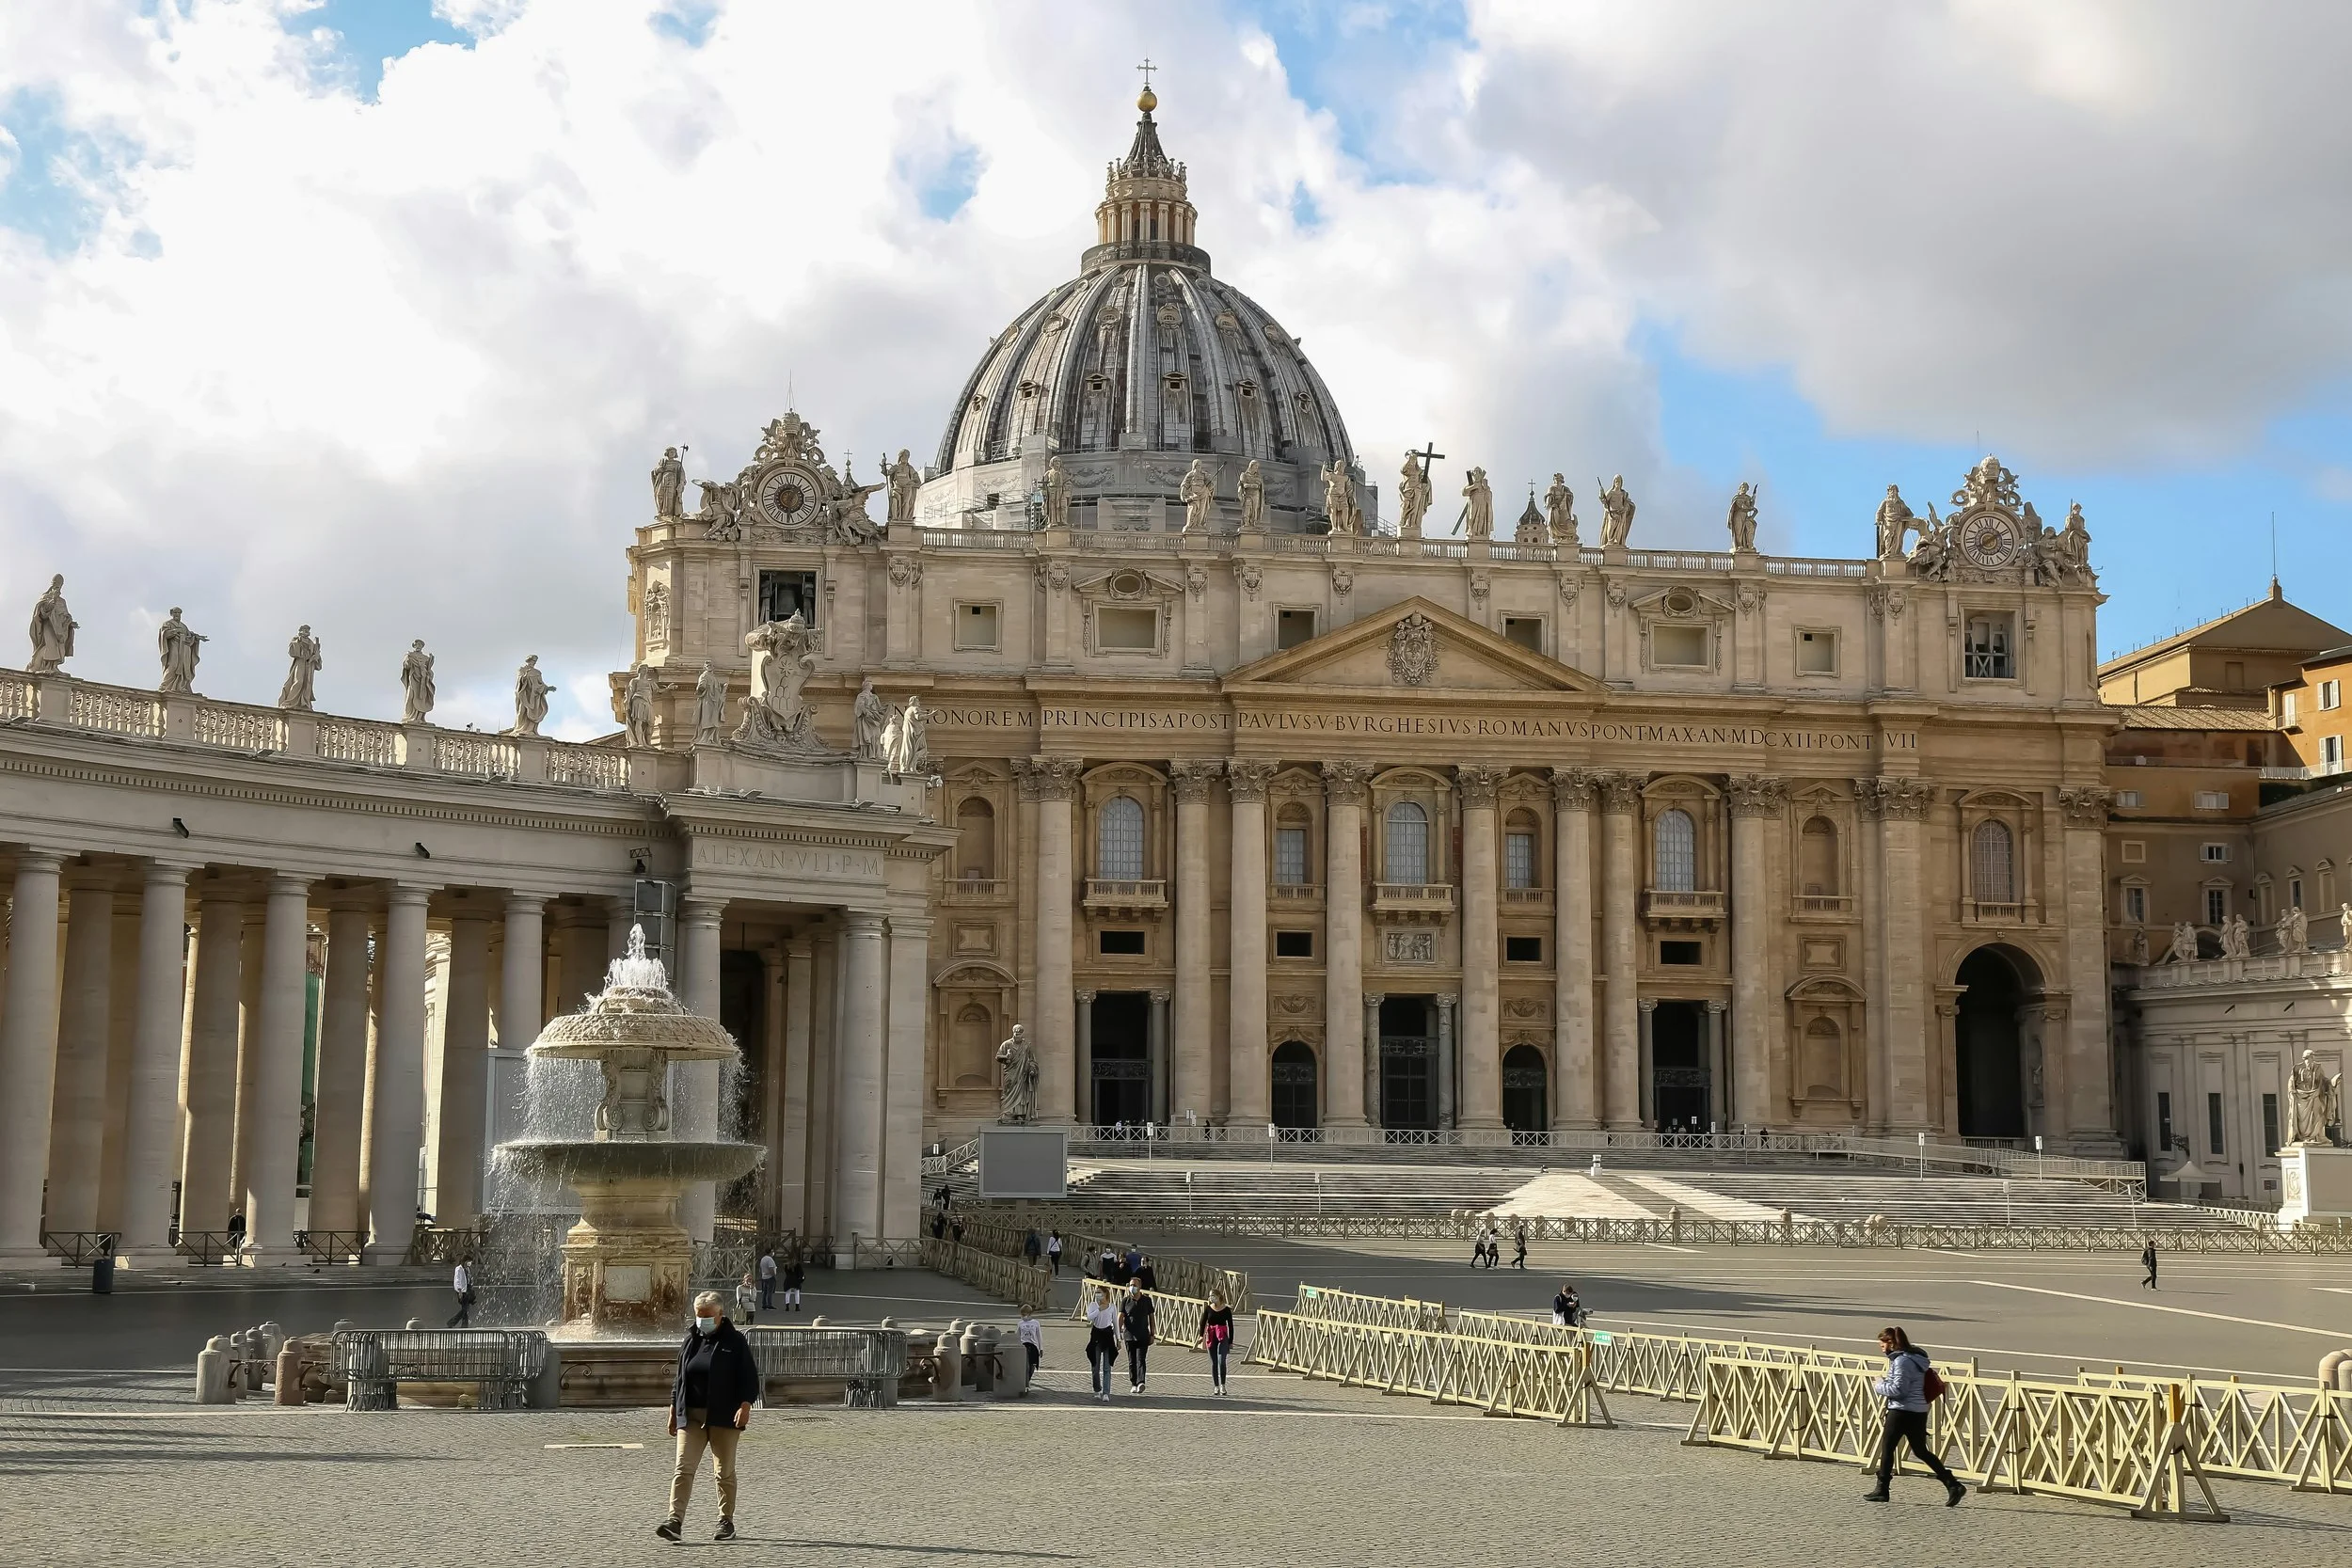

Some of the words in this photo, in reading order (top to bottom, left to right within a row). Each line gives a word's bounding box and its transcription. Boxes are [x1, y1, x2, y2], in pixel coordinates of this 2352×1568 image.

[1042, 710, 1157, 728] PRINCIPIS
[1162, 713, 1232, 729] APOST
[1238, 712, 1311, 729] PAVLVS
[1316, 715, 1329, 729] V
[1336, 716, 1470, 735] BVRGHESIVS
[1478, 720, 1588, 737] ROMANVS
[1590, 724, 1646, 741] PONT
[1648, 726, 1693, 742] MAX
[1697, 728, 1725, 743] AN
[1731, 729, 1811, 749] MDCXII
[1819, 734, 1873, 750] PONT
[1886, 733, 1916, 748] VII
[695, 845, 785, 869] ALEXAN
[797, 852, 833, 872] VII
[841, 855, 852, 873] P
[863, 857, 881, 876] M
